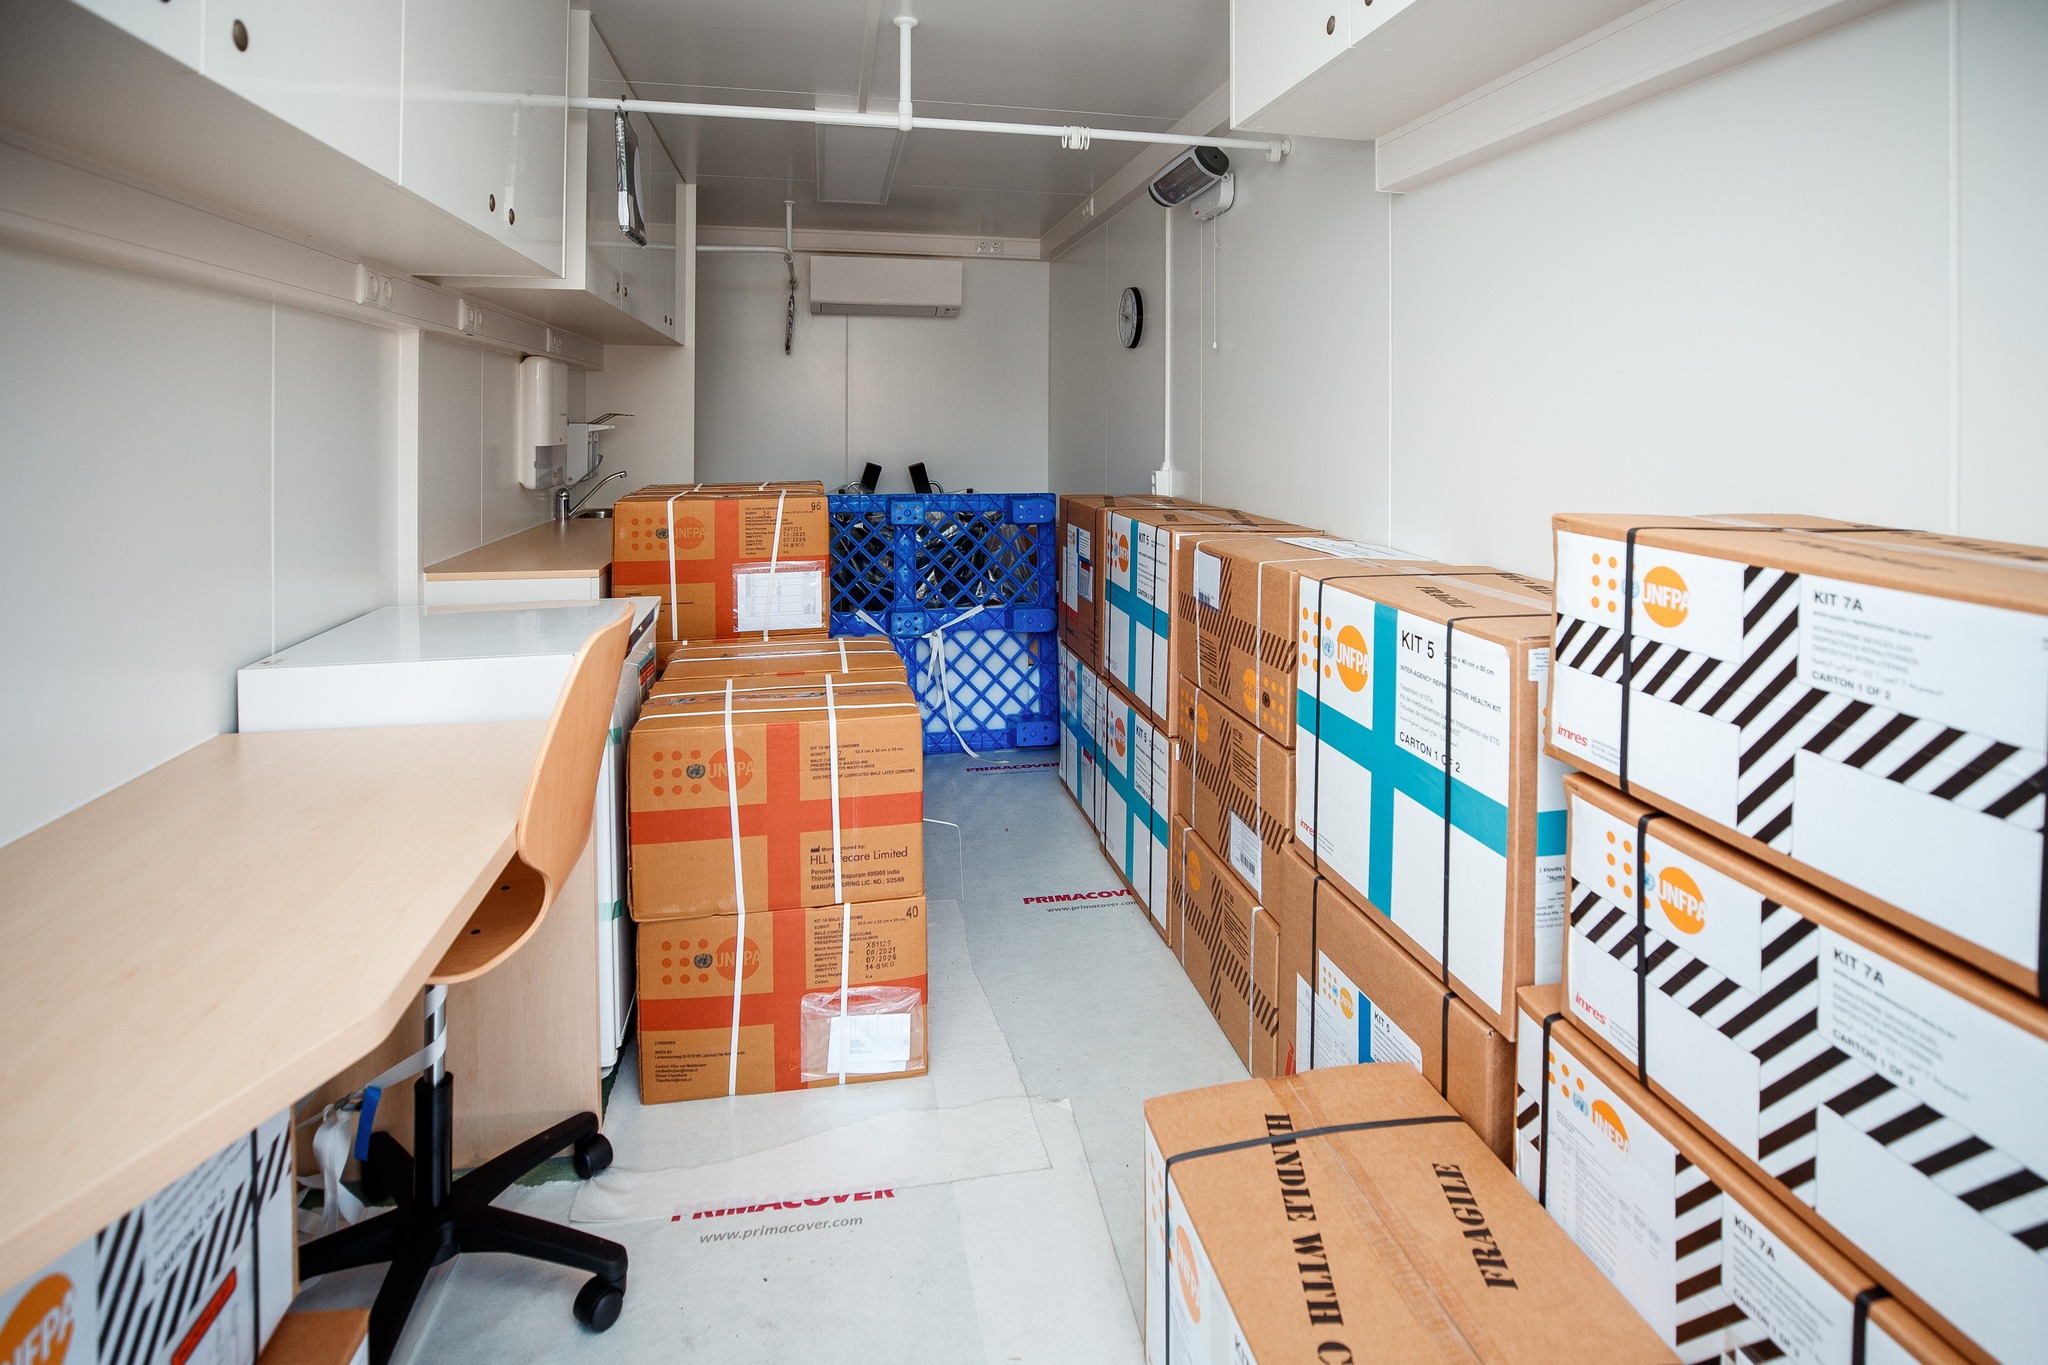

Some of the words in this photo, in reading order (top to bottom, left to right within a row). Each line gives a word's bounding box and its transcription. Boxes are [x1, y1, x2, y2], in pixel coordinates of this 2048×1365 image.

[811, 502, 821, 510] 96
[1146, 535, 1149, 545] 5
[1642, 582, 1691, 612] UNFPA
[1814, 591, 1838, 606] KIT
[1842, 595, 1863, 612] 7A
[1401, 630, 1422, 653] KIT
[1427, 640, 1435, 659] 5
[1337, 640, 1369, 677] UNFPA
[1400, 665, 1432, 682] INTER-AGENCY
[1471, 695, 1492, 709] HEALTH
[1812, 670, 1855, 690] CARTON
[1858, 683, 1862, 692] 1
[1866, 686, 1881, 696] OF
[1144, 732, 1147, 743] 5
[1557, 722, 1588, 746] imres
[1399, 731, 1432, 758] CARTON
[1455, 762, 1460, 773] 2
[1300, 817, 1314, 837] imre
[810, 855, 828, 865] HLL
[873, 846, 908, 860] Limited
[811, 880, 860, 890] MANUFAURING
[1023, 889, 1133, 904] PRIMACOV
[906, 906, 919, 918] 40
[1658, 876, 1708, 922] UNFPA
[714, 951, 761, 968] UNPA
[1833, 948, 1859, 970] KIT
[1863, 964, 1885, 986] 7A
[1575, 990, 1607, 1025] imres
[1375, 1012, 1384, 1027] KIT
[1386, 1023, 1390, 1033] 5
[1832, 1028, 1878, 1062] CARTON
[700, 1216, 863, 1244] www.primacover.com
[1432, 1162, 1520, 1292] FRAGILE
[1734, 1216, 1754, 1239] KIT
[1759, 1236, 1776, 1261] 7A
[1292, 1232, 1344, 1327] WITH
